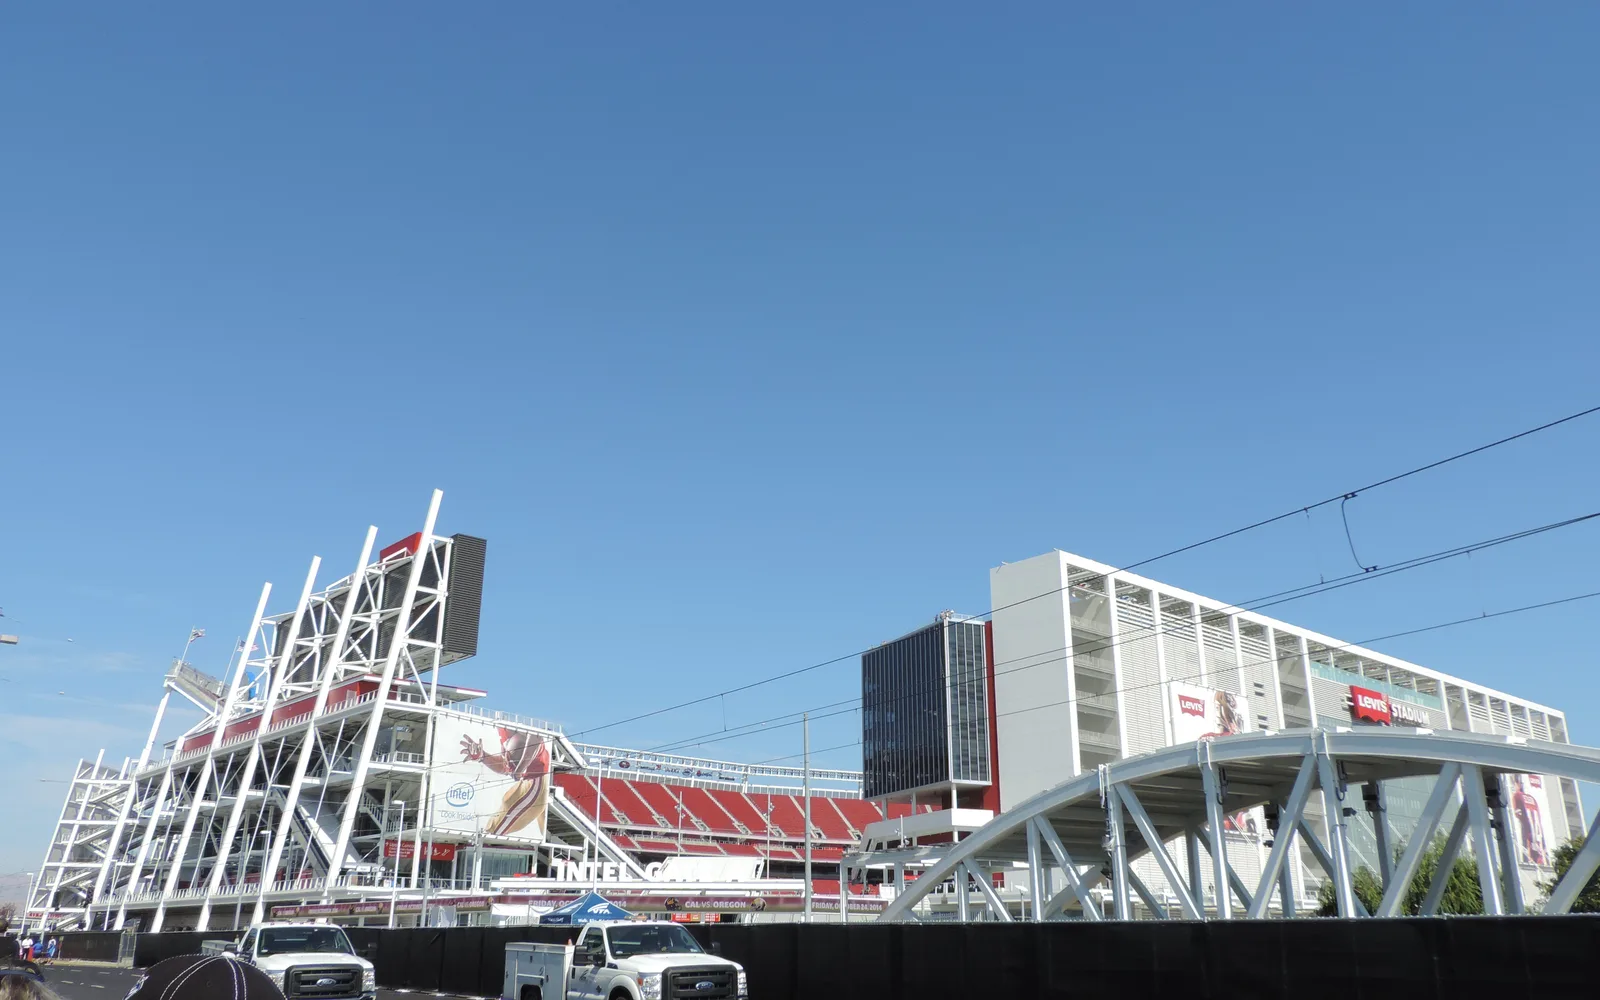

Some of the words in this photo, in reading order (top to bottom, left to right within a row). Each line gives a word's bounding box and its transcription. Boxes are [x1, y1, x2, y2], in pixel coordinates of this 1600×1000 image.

[1391, 703, 1430, 725] STADIUM
[450, 786, 470, 800] intel
[556, 860, 634, 882] INTEL
[713, 901, 746, 909] OREGON
